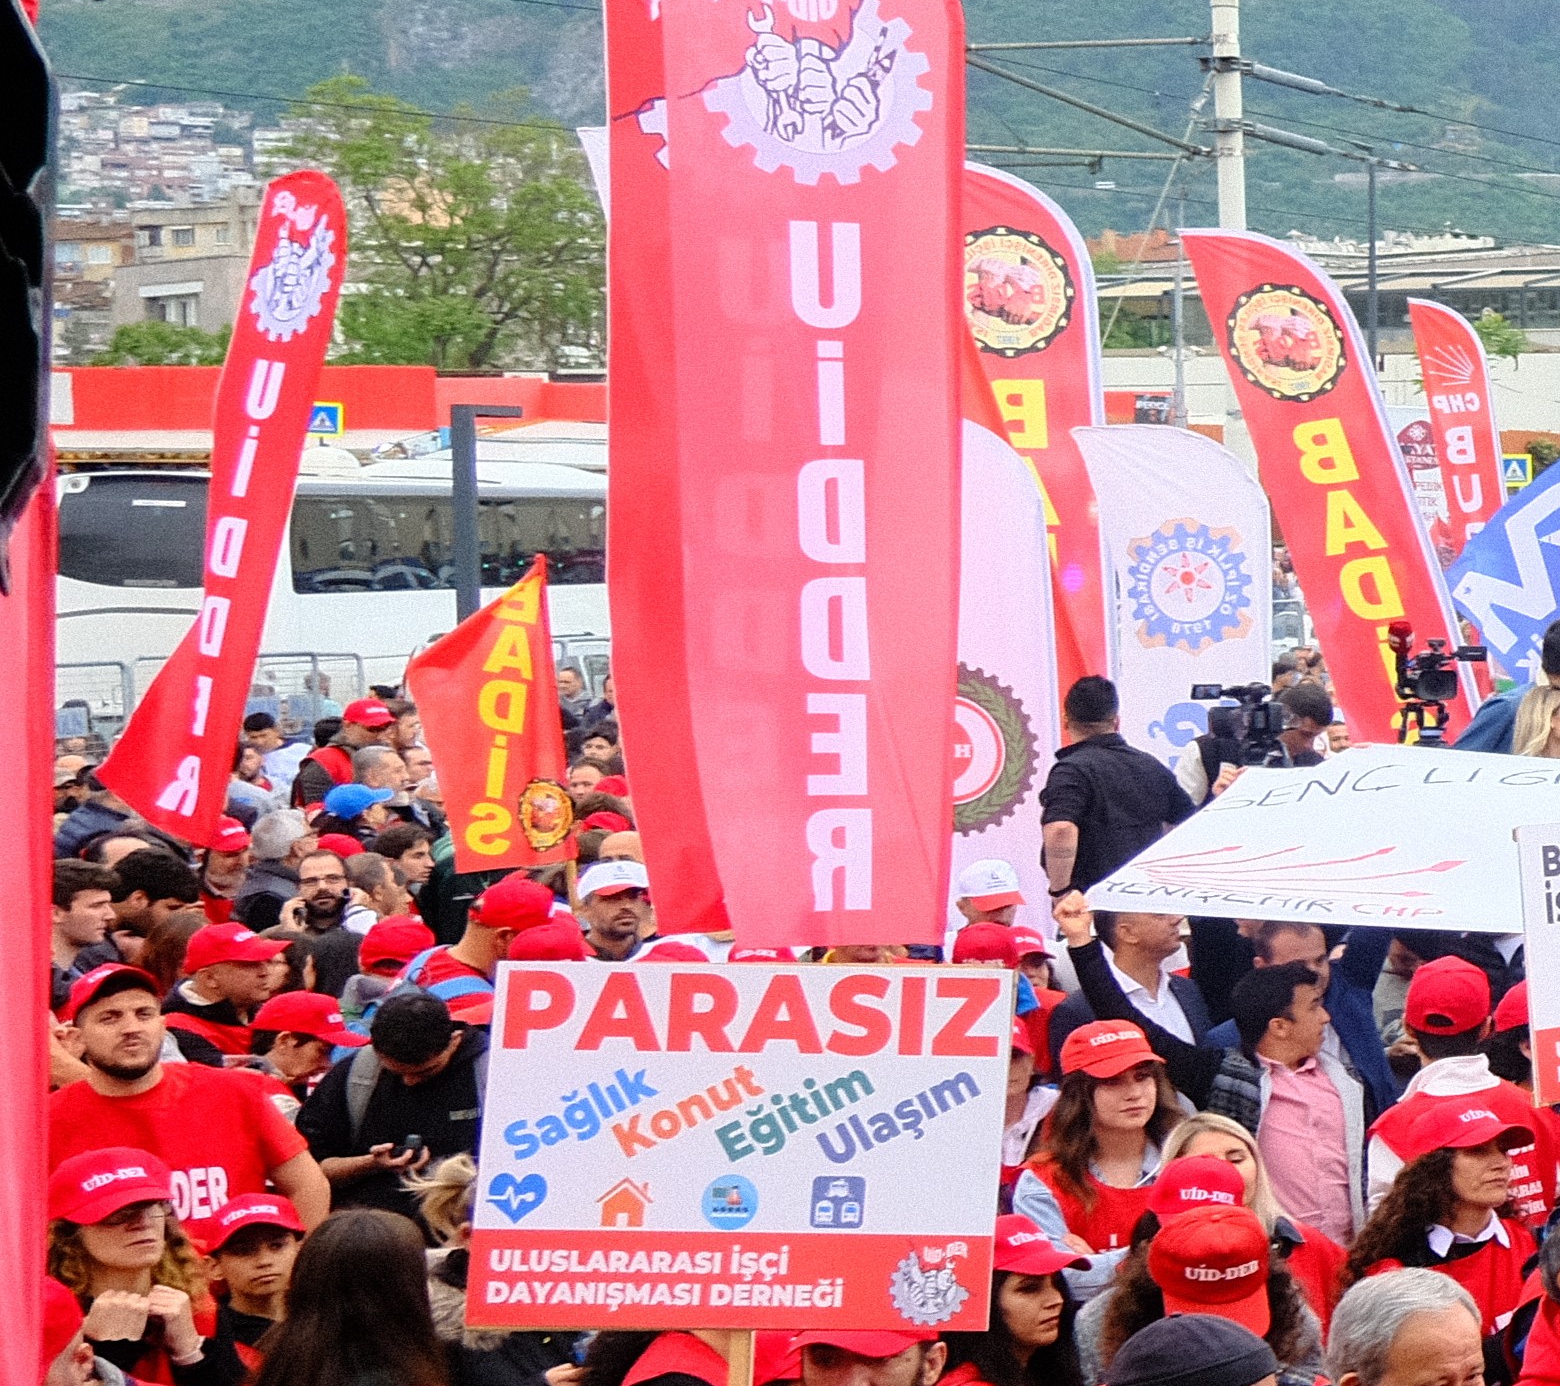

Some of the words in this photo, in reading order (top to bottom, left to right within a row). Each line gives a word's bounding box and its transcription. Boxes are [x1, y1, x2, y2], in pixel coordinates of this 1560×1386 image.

[502, 970, 1000, 1058] PARASIZ
[502, 1065, 659, 1162] Sağlık
[610, 1064, 766, 1158] Konut
[714, 1065, 876, 1163] Eğitim
[816, 1070, 981, 1164] Ulaşım
[486, 1279, 701, 1313] DAYANIŞMASI
[710, 1276, 843, 1309] DERNEĞİ
[489, 1247, 723, 1275] ULUSLARARASI
[730, 1244, 789, 1284] İŞÇİ
